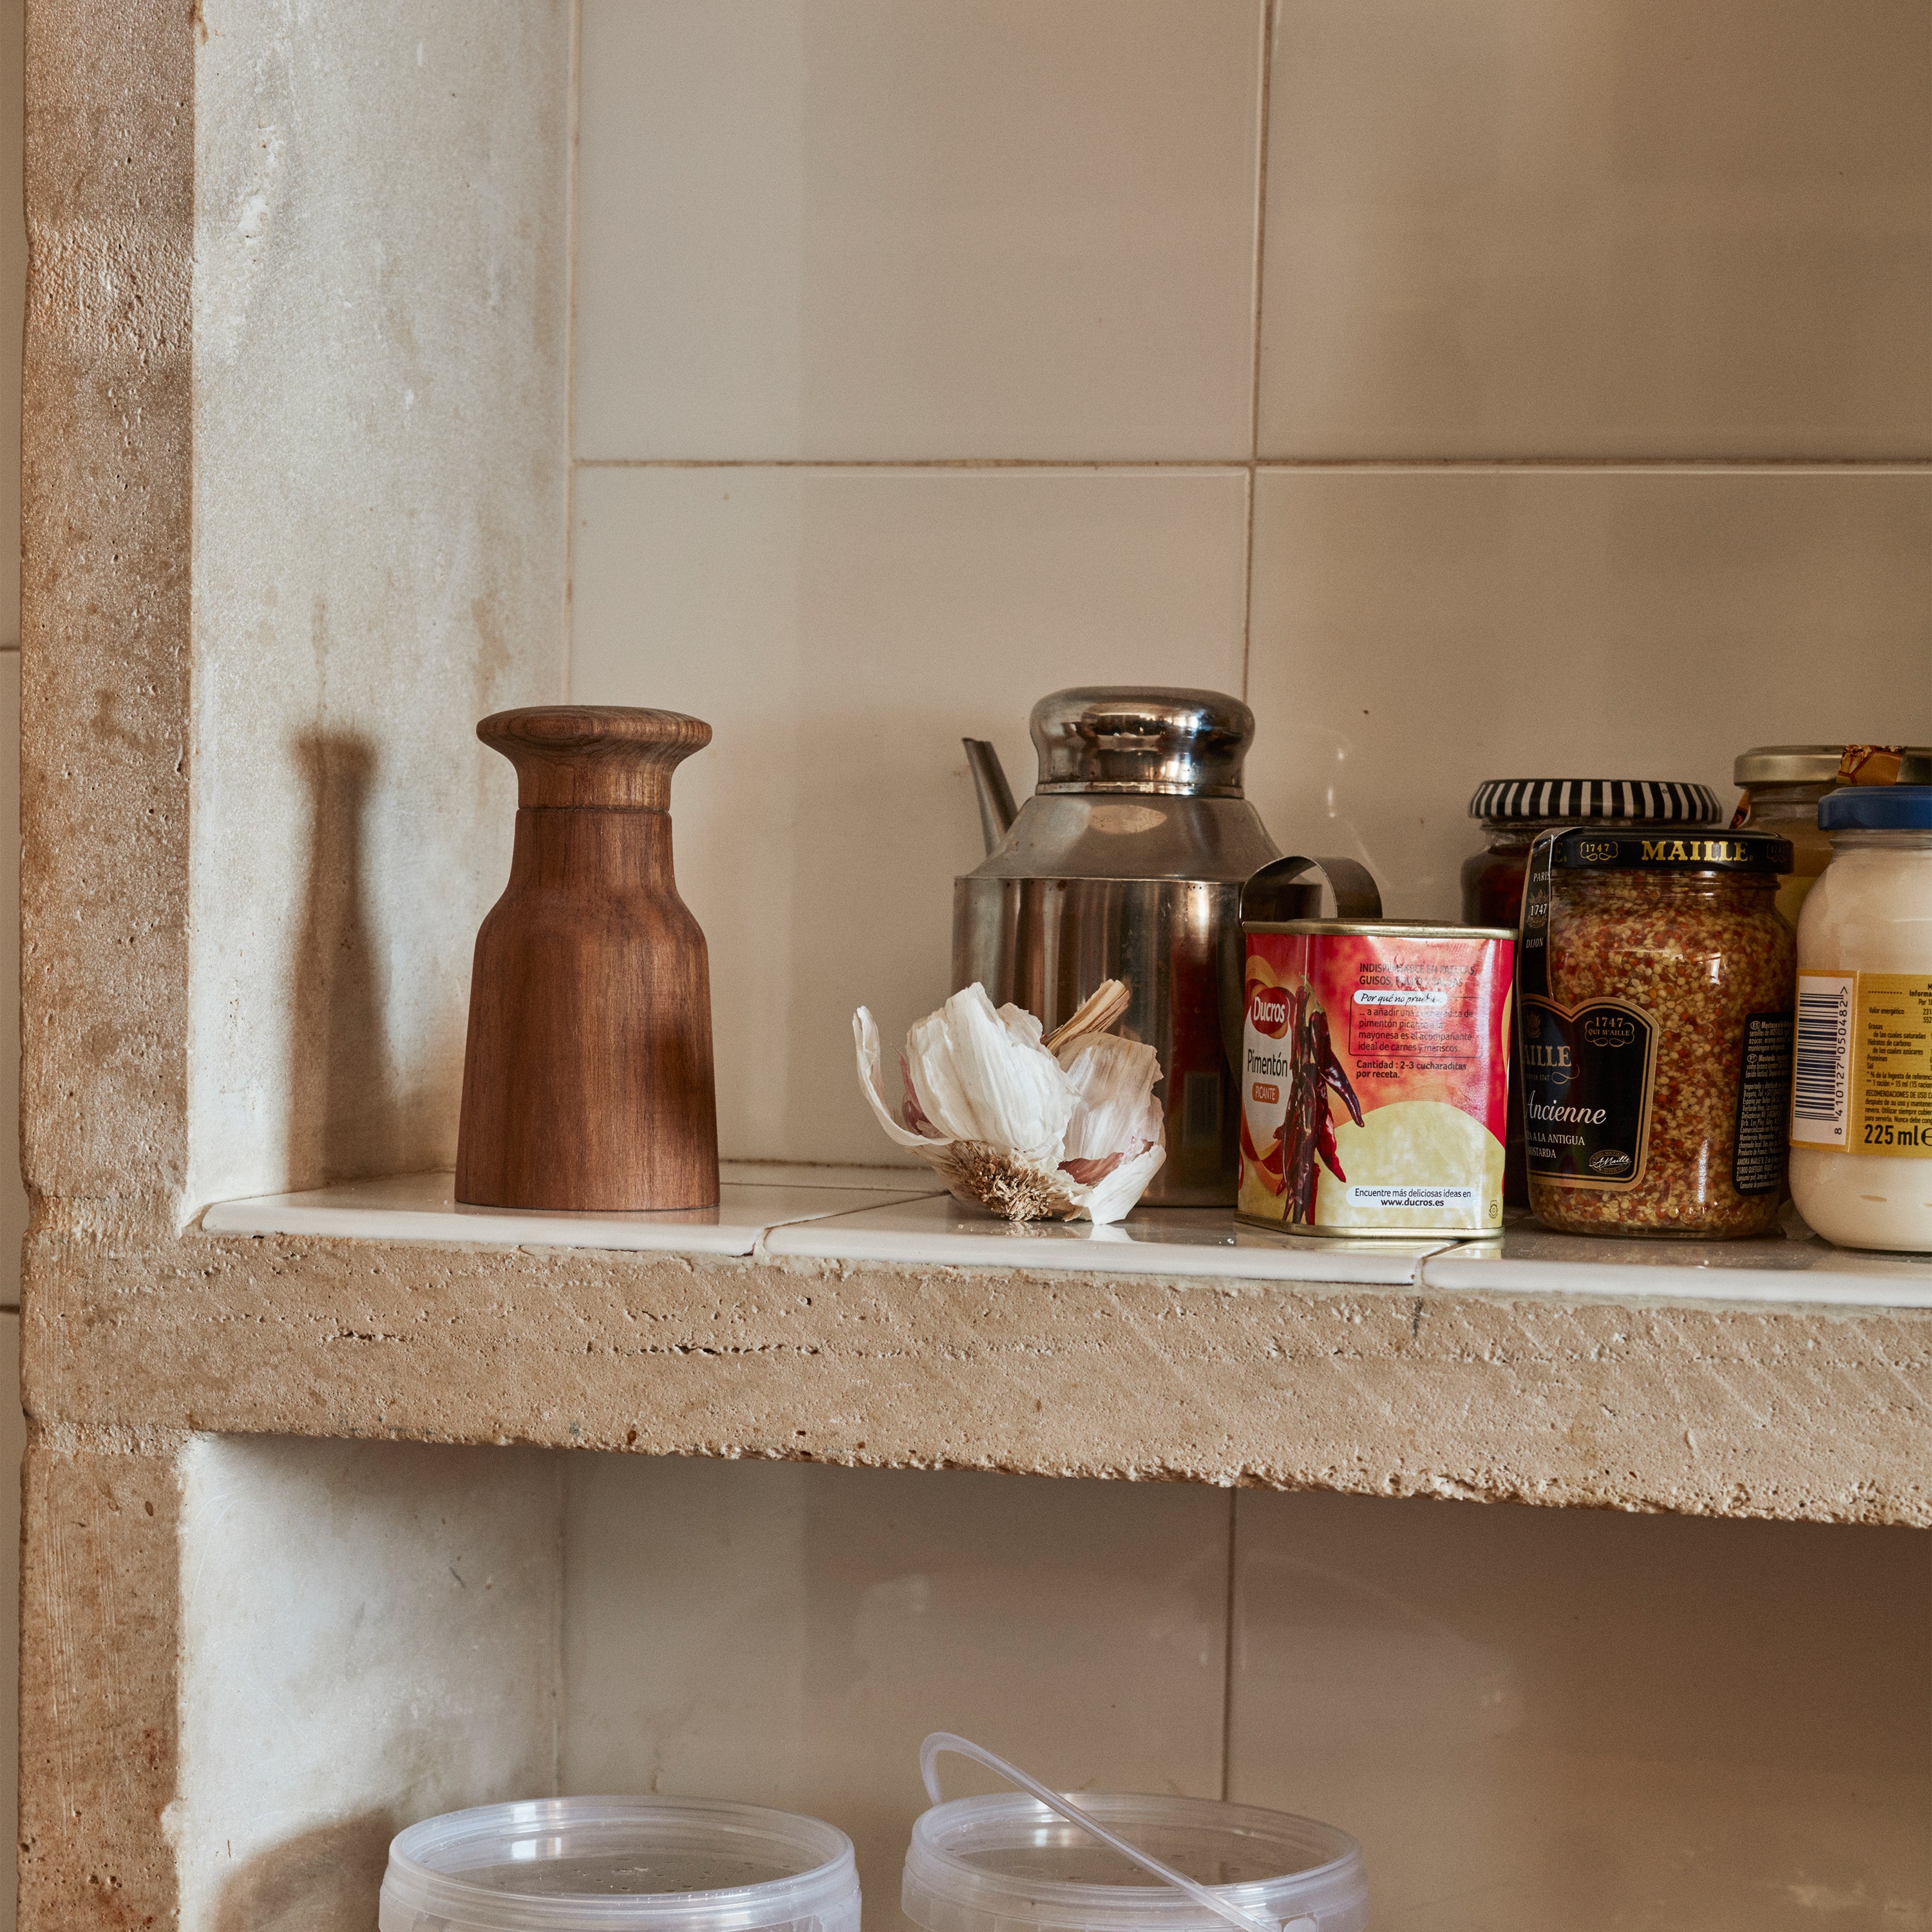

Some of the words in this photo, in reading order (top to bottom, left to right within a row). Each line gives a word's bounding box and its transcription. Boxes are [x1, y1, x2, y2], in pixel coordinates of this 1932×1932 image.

[1586, 844, 1610, 852] 1747
[1642, 840, 1749, 862] MAILLE
[1533, 870, 1550, 882] PARIS
[1530, 902, 1548, 916] 1747
[1526, 938, 1544, 949] DIJON
[1359, 976, 1393, 987] GUISOS,
[1361, 993, 1376, 1002] Por
[1378, 994, 1394, 1006] qué
[1254, 996, 1286, 1023] Ducros
[1374, 1008, 1399, 1016] añadir
[1464, 1009, 1473, 1018] de
[1881, 1007, 1904, 1016] energético
[1359, 1019, 1397, 1030] pimentón
[1595, 1017, 1624, 1028] 1747
[1358, 1032, 1399, 1041] mayonesa
[1358, 1041, 1378, 1050] ideal
[1379, 1042, 1388, 1051] de
[1390, 1043, 1417, 1052] carnes
[1524, 1045, 1571, 1068] AILLE
[1247, 1048, 1288, 1077] Pimentón
[1356, 1060, 1394, 1069] Cantidad
[1400, 1061, 1414, 1069] 2-3
[1417, 1062, 1467, 1070] cucharaditas
[1356, 1070, 1370, 1079] por
[1255, 1086, 1276, 1101] PICANTE
[1836, 1064, 1845, 1117] 410127
[1866, 1090, 1909, 1098] RECOMENDACIONES
[1899, 1108, 1917, 1116] siempre
[1548, 1133, 1586, 1146] ANTIGUA
[1864, 1124, 1893, 1145] 225
[1897, 1126, 1918, 1146] ml
[1529, 1146, 1557, 1159] OSTARDA
[1355, 1188, 1391, 1197] Encuentre
[1392, 1189, 1407, 1197] más
[1408, 1189, 1442, 1198] deliciosas
[1443, 1189, 1461, 1198] ideas
[1381, 1198, 1444, 1206] www.ducros.es
